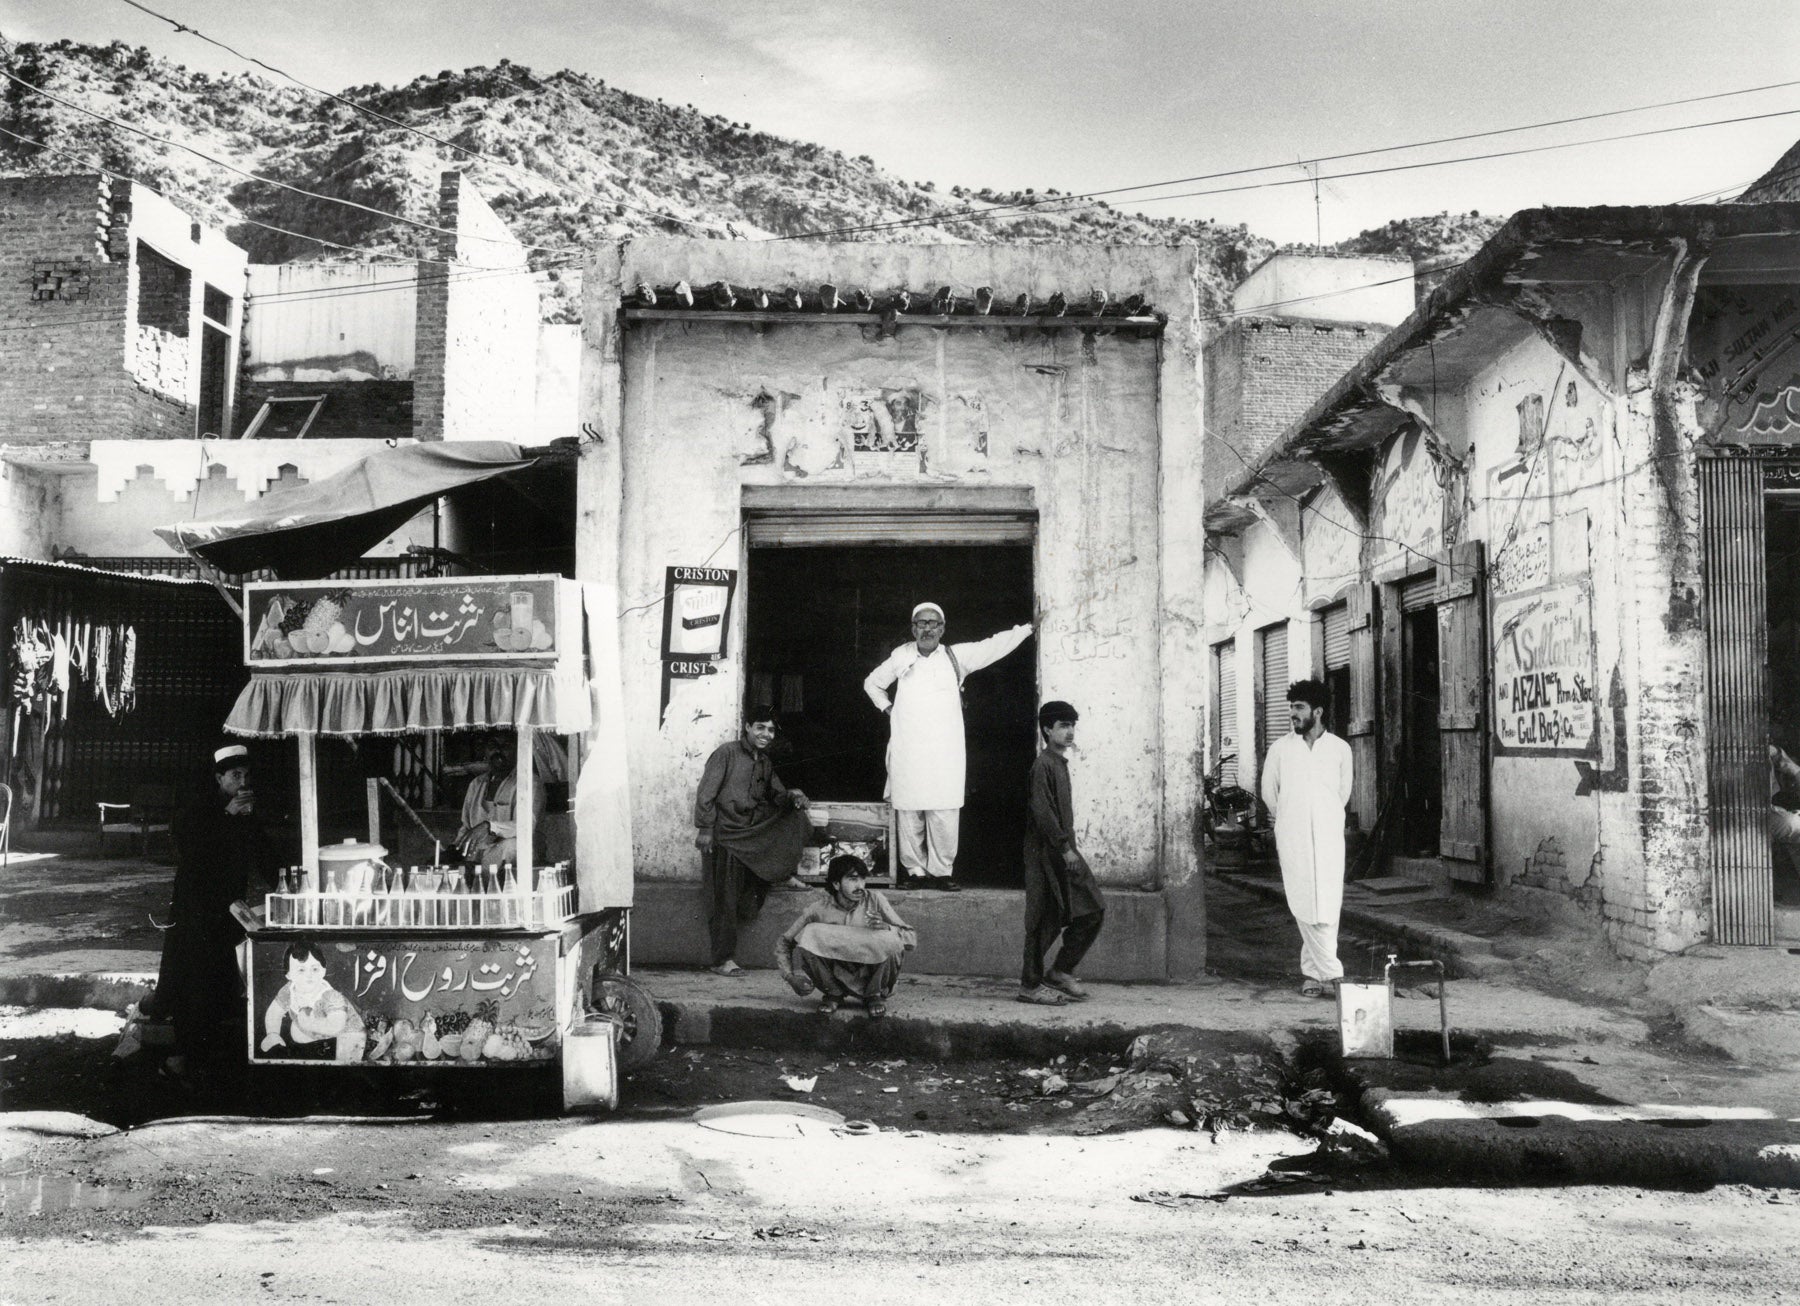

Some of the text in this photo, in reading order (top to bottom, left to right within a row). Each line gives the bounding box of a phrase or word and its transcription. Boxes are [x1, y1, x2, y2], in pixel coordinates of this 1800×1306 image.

[673, 567, 730, 582] CRISTON
[421, 594, 485, 645] شربت
[689, 614, 719, 627] CRISTON
[1512, 671, 1552, 714] AFZAL
[1517, 711, 1538, 745] Gul
[355, 950, 397, 998] افزا
[472, 946, 539, 1001] شربت
